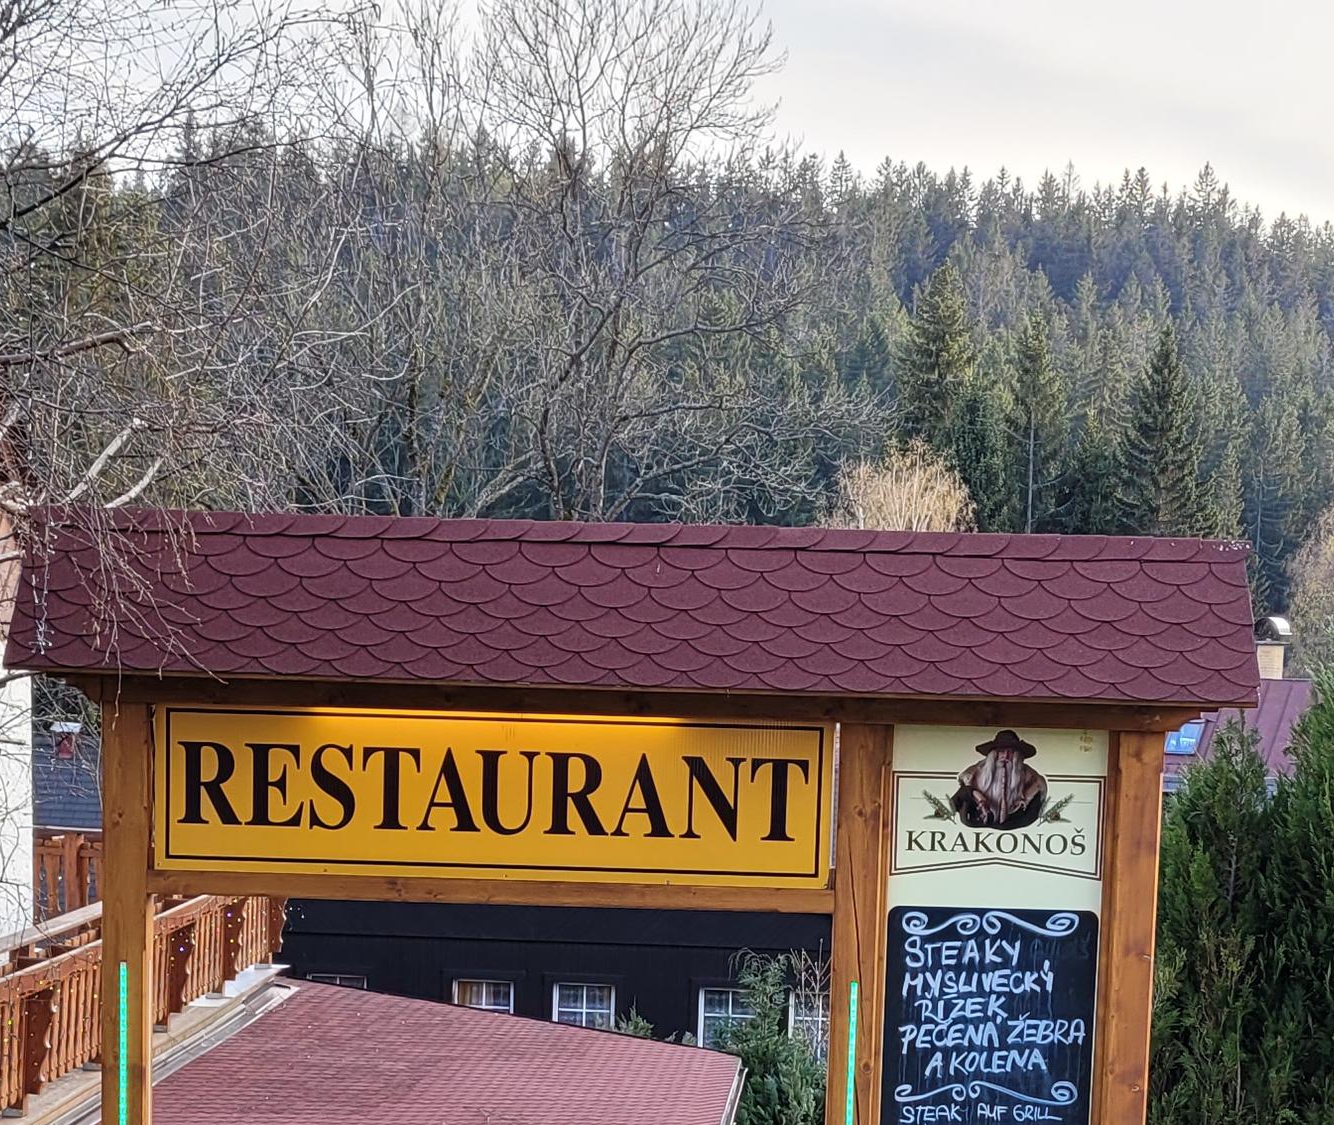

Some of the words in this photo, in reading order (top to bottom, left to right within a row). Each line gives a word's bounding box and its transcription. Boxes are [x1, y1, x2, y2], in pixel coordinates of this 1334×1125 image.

[175, 739, 810, 842] RESTAURANT
[905, 827, 1087, 856] KRAKONOŠ
[904, 935, 1021, 968] STEAKY
[1006, 1011, 1087, 1046] ŽEBRA
[924, 1051, 944, 1079] A
[949, 1048, 1048, 1076] KOLENA
[899, 1103, 964, 1125] STEAK
[977, 1102, 1009, 1122] AUF
[1012, 1105, 1063, 1122] GRILL
